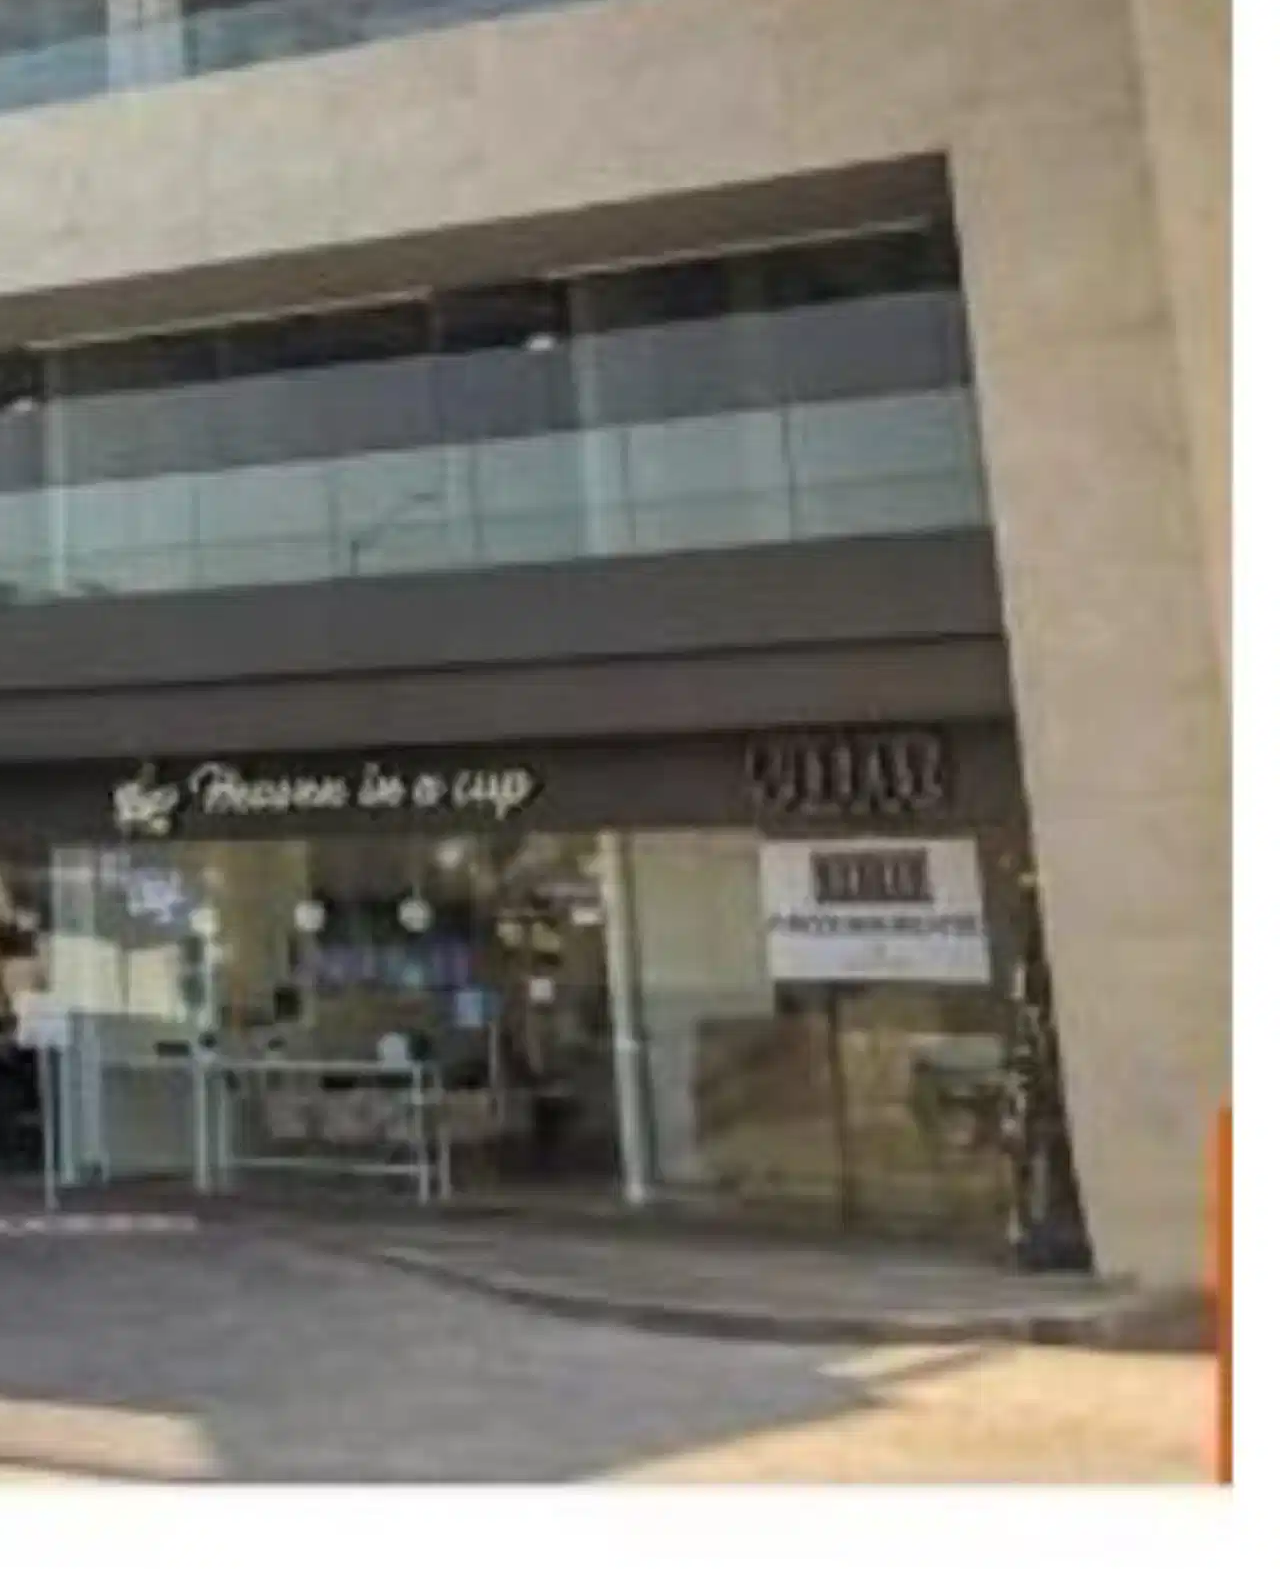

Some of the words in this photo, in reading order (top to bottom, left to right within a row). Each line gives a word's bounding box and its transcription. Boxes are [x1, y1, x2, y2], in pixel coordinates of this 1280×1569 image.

[357, 761, 405, 808] in
[412, 773, 445, 808] a
[452, 767, 534, 820] cup
